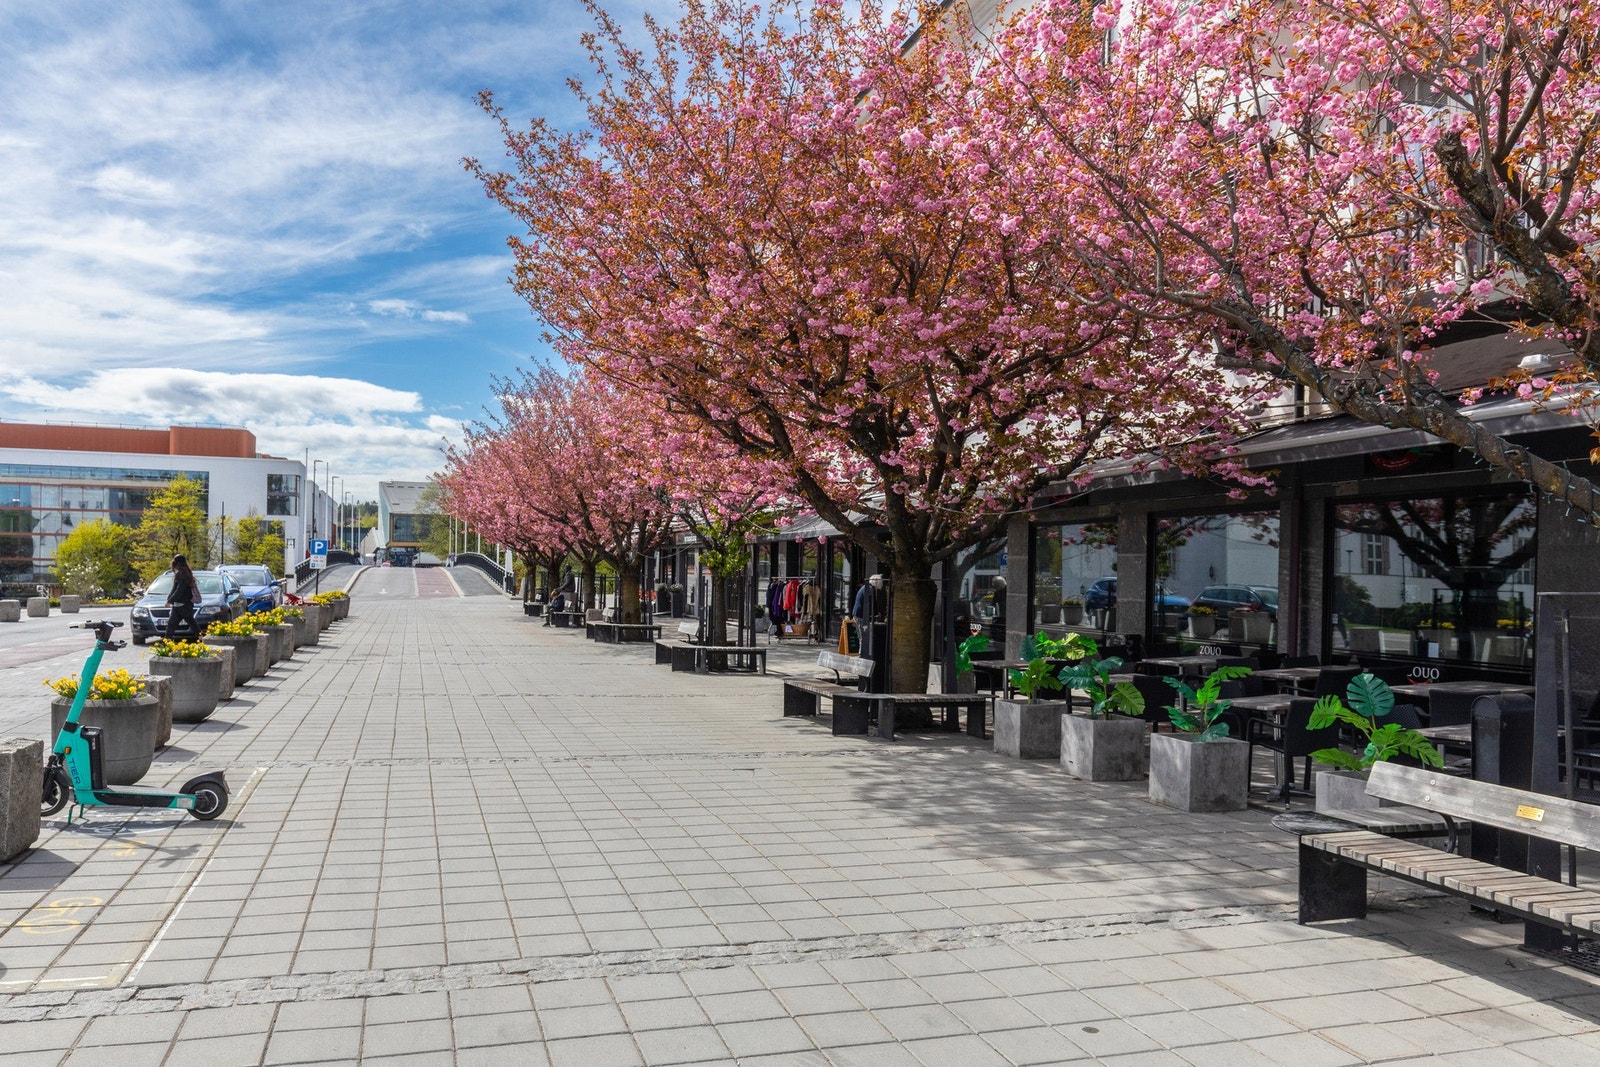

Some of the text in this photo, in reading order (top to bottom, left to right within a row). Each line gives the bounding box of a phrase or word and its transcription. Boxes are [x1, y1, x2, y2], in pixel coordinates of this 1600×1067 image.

[315, 541, 324, 553] P
[1200, 645, 1221, 656] ZOUO
[1407, 666, 1440, 679] OUO
[70, 758, 80, 784] TIER
